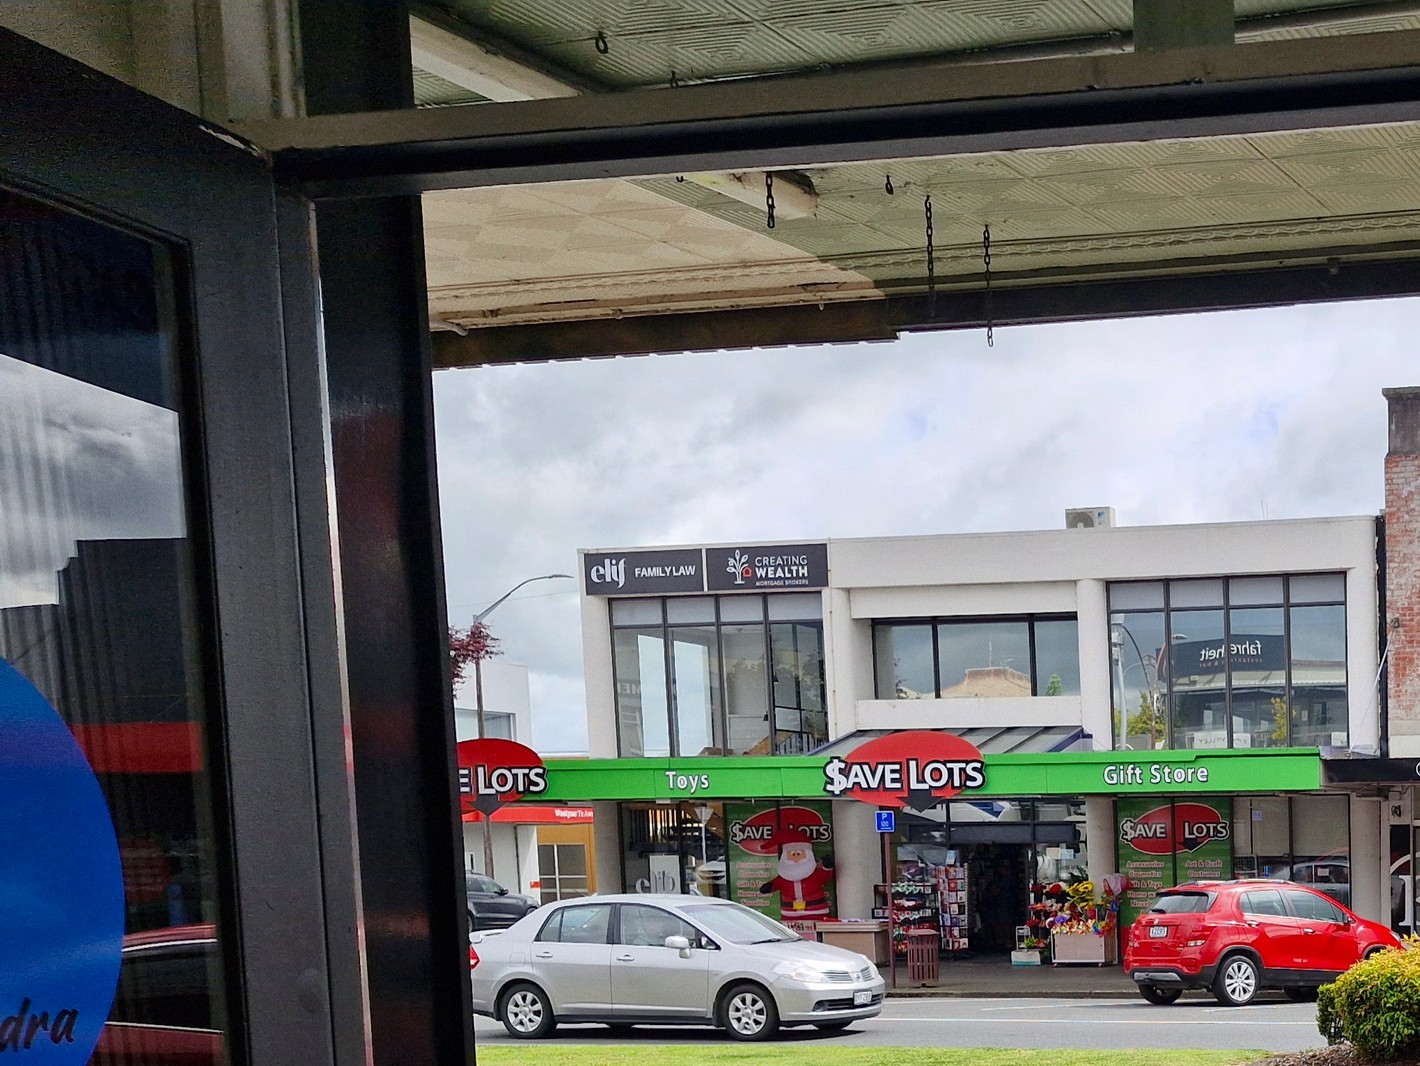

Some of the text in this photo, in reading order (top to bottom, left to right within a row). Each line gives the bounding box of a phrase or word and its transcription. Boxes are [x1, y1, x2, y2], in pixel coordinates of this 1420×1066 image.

[755, 556, 808, 566] CREATING
[590, 558, 626, 588] elif
[635, 565, 696, 578] FAMILY LAW
[755, 566, 808, 578] WEALTH
[478, 766, 545, 794] LOTS
[666, 771, 709, 794] Toys
[909, 761, 984, 790] LOTS
[1104, 765, 1208, 784] Gift Store
[1184, 822, 1227, 838] LOTS
